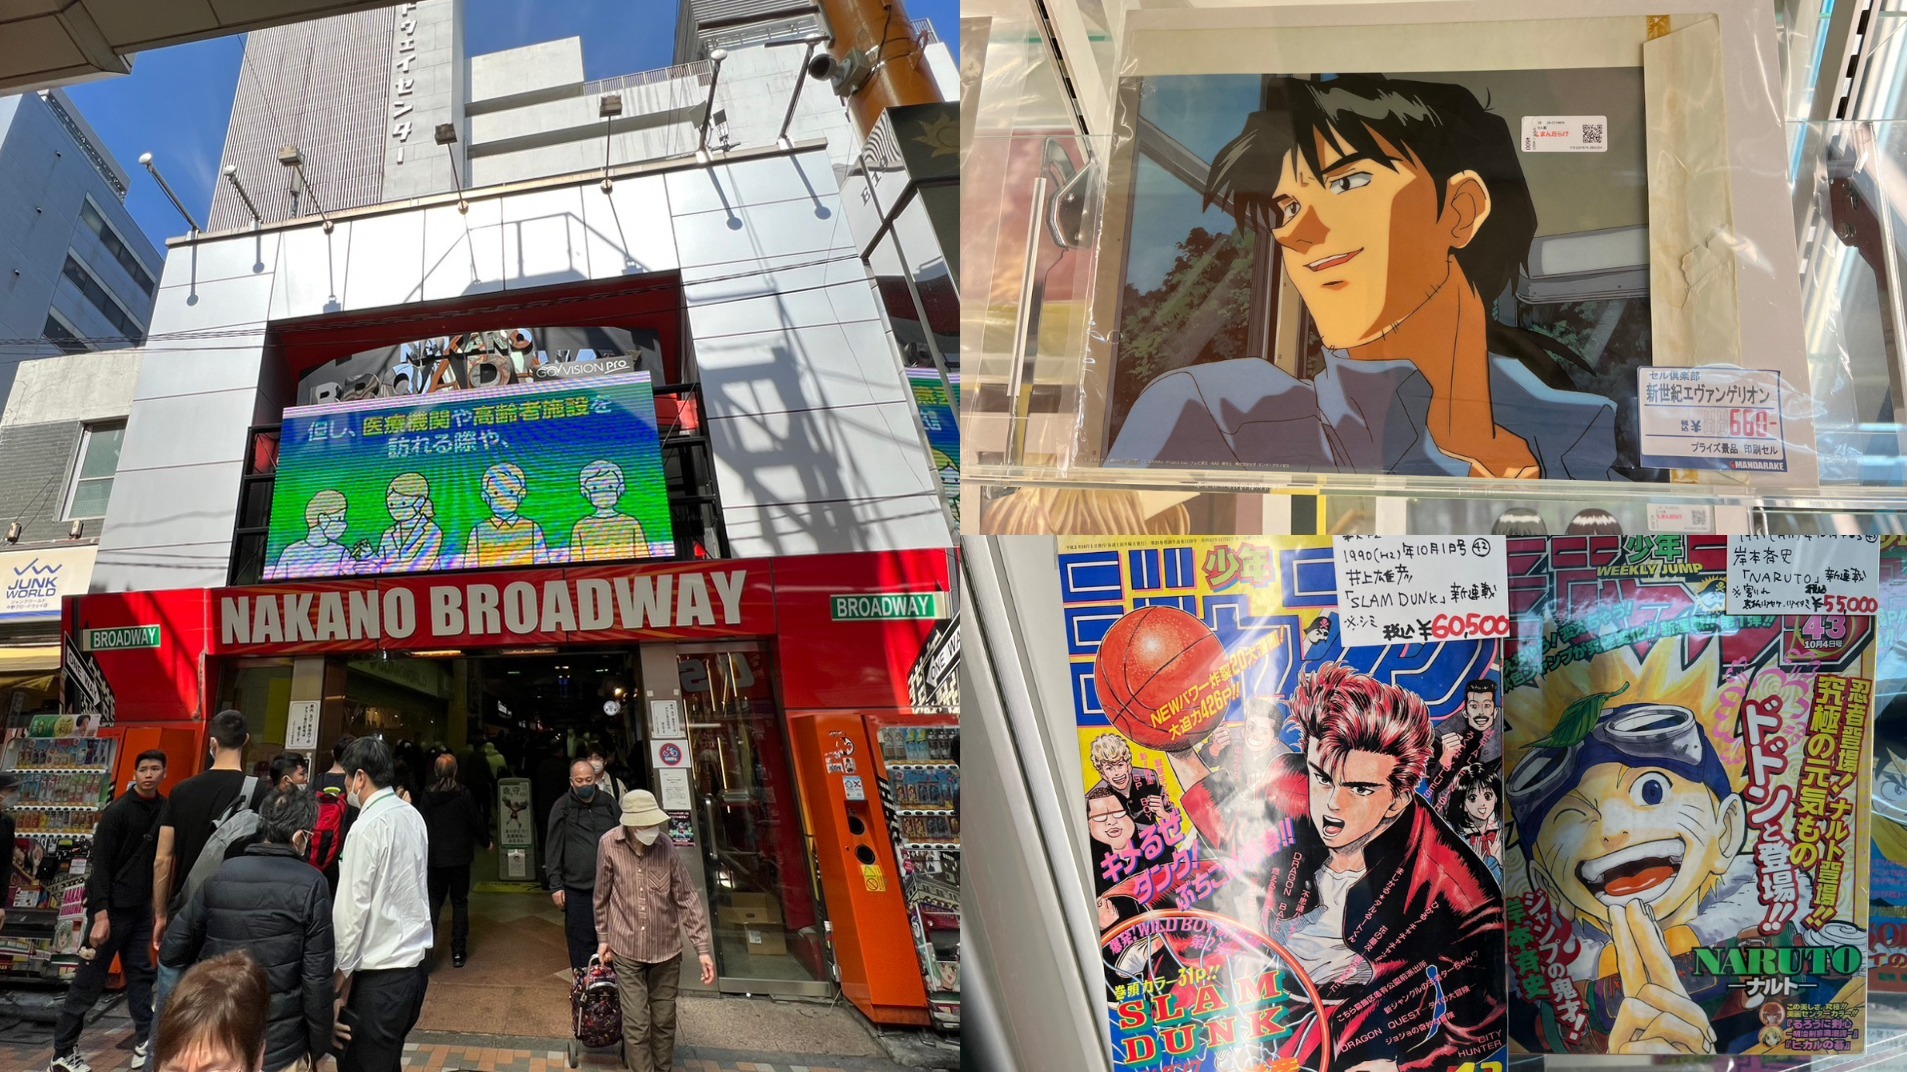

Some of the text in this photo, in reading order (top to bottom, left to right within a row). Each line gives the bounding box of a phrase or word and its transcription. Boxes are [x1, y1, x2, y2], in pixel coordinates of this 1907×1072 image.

[563, 362, 604, 375] VISION
[1650, 371, 1701, 382] セル倶楽部
[1646, 384, 1770, 404] 新世紀エヴァンゲリオン
[1734, 461, 1785, 471] MANDARAKE
[1626, 535, 1685, 563] 少年
[1202, 545, 1273, 591] 少年
[1597, 562, 1704, 577] WEEKLY JUMP
[6, 588, 56, 599] WORLD
[8, 577, 58, 590] JUNK
[221, 569, 747, 645] NAKANO BROADWAY
[836, 594, 930, 618] BROADWAY
[93, 627, 156, 648] BROADWAY
[1802, 616, 1847, 640] 43
[1804, 640, 1843, 650] 10月4日号
[1789, 676, 1847, 869] 究極の元気もの
[1100, 807, 1187, 884] キメるぜ
[1132, 838, 1200, 905] ダンク!
[1283, 851, 1302, 896] DRAGON
[1524, 890, 1587, 1041] ジャンプの鬼才!
[1693, 946, 1863, 977] NARUTO
[1117, 970, 1287, 1031] SLAM
[1336, 960, 1428, 1022] こちら葛飾区亀有公園前派出所
[1122, 1004, 1290, 1065] DUNK
[1340, 1027, 1383, 1053] DRAGON
[1477, 1029, 1502, 1044] CITY
[1457, 1039, 1502, 1058] HUNTER
